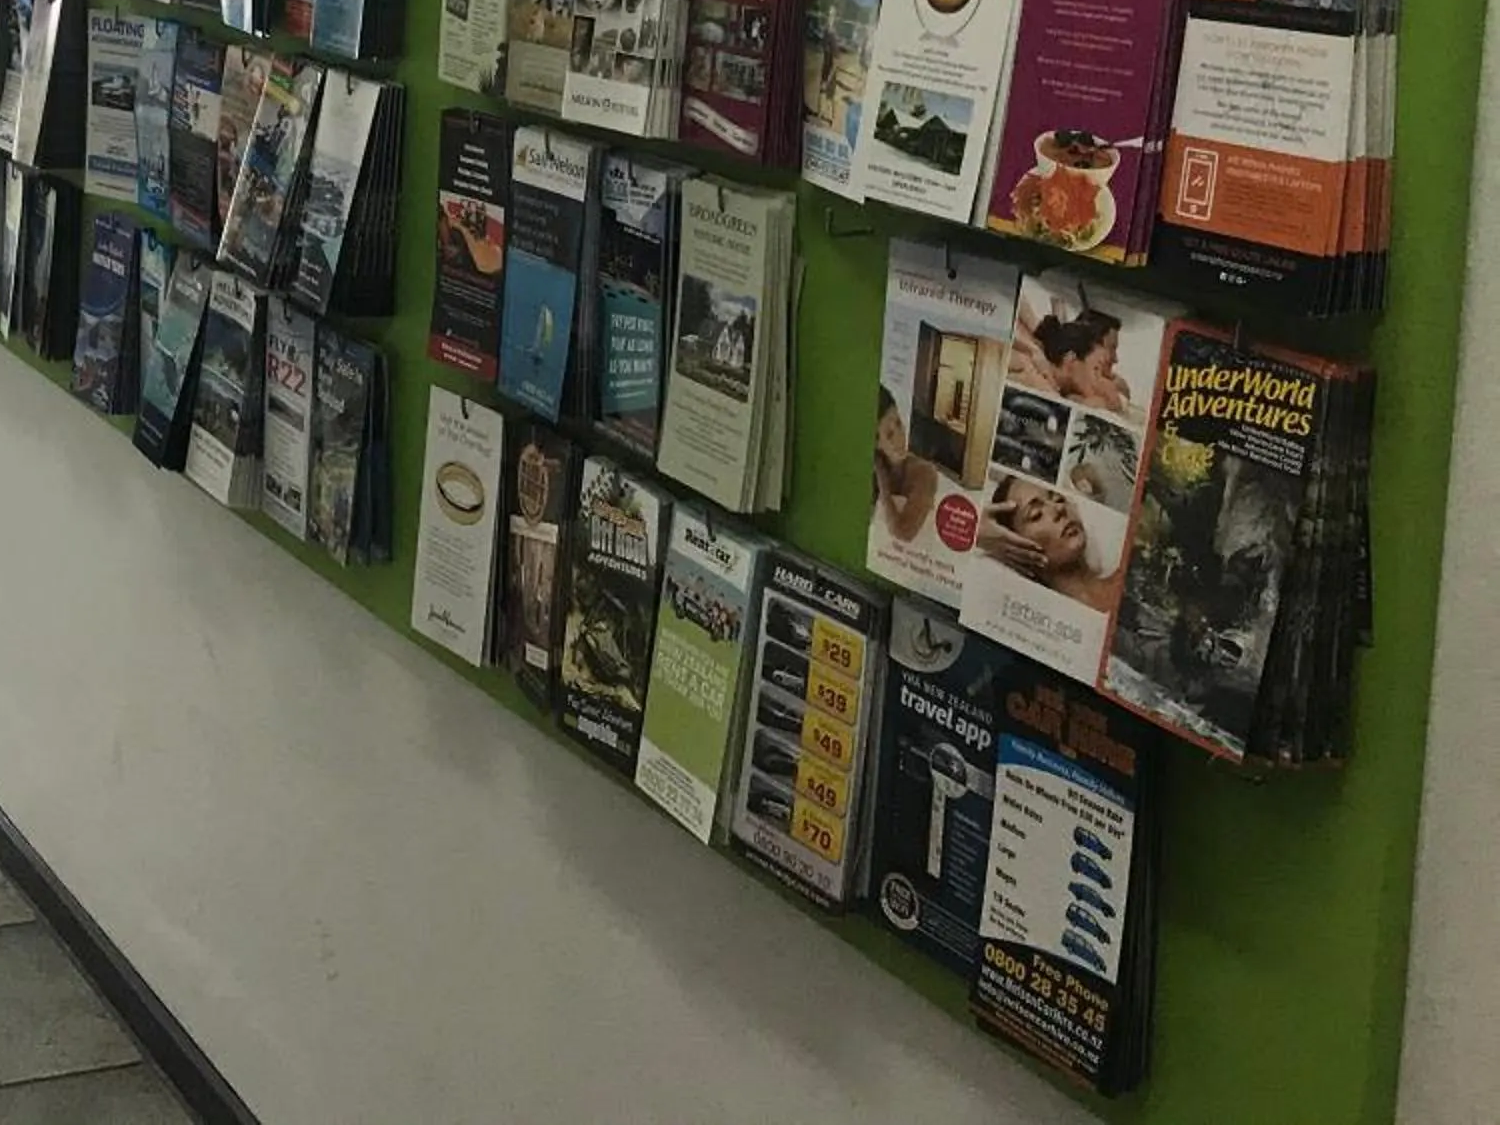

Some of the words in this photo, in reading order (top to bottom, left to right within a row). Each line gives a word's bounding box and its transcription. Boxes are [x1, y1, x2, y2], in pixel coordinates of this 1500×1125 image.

[91, 16, 145, 38] FLOATING
[899, 278, 945, 300] Infrared
[948, 287, 998, 317] Therapy
[267, 353, 306, 398] R22
[1166, 364, 1316, 409] UnderWorld
[1162, 391, 1313, 436] Adventures
[587, 552, 648, 581] ADVENTURES
[824, 589, 860, 616] CARS
[822, 637, 852, 668] $29
[818, 683, 848, 714] $39
[901, 684, 954, 730] travel
[955, 716, 992, 752] app
[813, 728, 842, 759] $49
[808, 777, 837, 808] $49
[803, 819, 832, 850] $70
[984, 942, 1026, 981] 0800
[1030, 973, 1052, 998] 28
[1056, 988, 1078, 1015] 35
[1033, 954, 1062, 982] Free
[1065, 975, 1109, 1012] Phone
